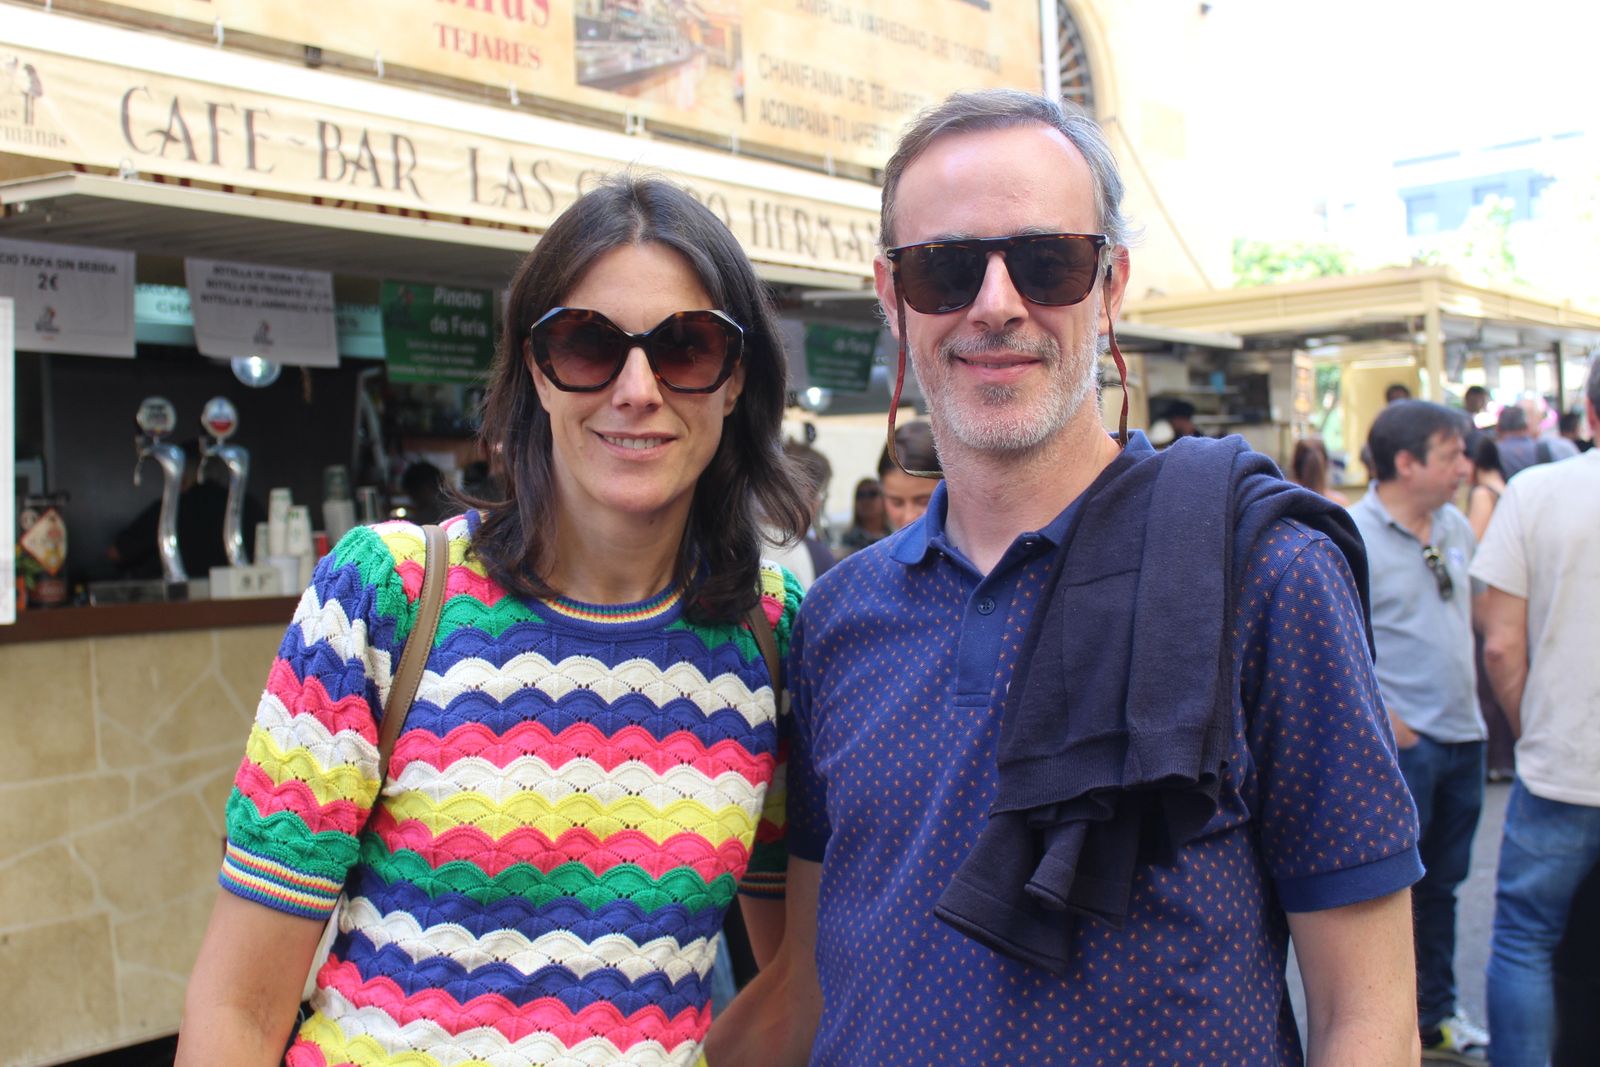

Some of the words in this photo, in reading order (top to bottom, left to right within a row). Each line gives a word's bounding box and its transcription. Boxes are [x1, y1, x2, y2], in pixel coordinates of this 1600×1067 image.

[434, 23, 541, 70] TEJARES
[848, 77, 868, 106] DE
[468, 146, 557, 217] LAS
[22, 254, 53, 269] TAPA
[56, 258, 76, 272] SIN
[78, 261, 117, 275] BEBIDA
[37, 271, 59, 292] 2€
[433, 286, 484, 310] Pincho
[430, 313, 449, 335] de
[451, 314, 487, 338] Feria
